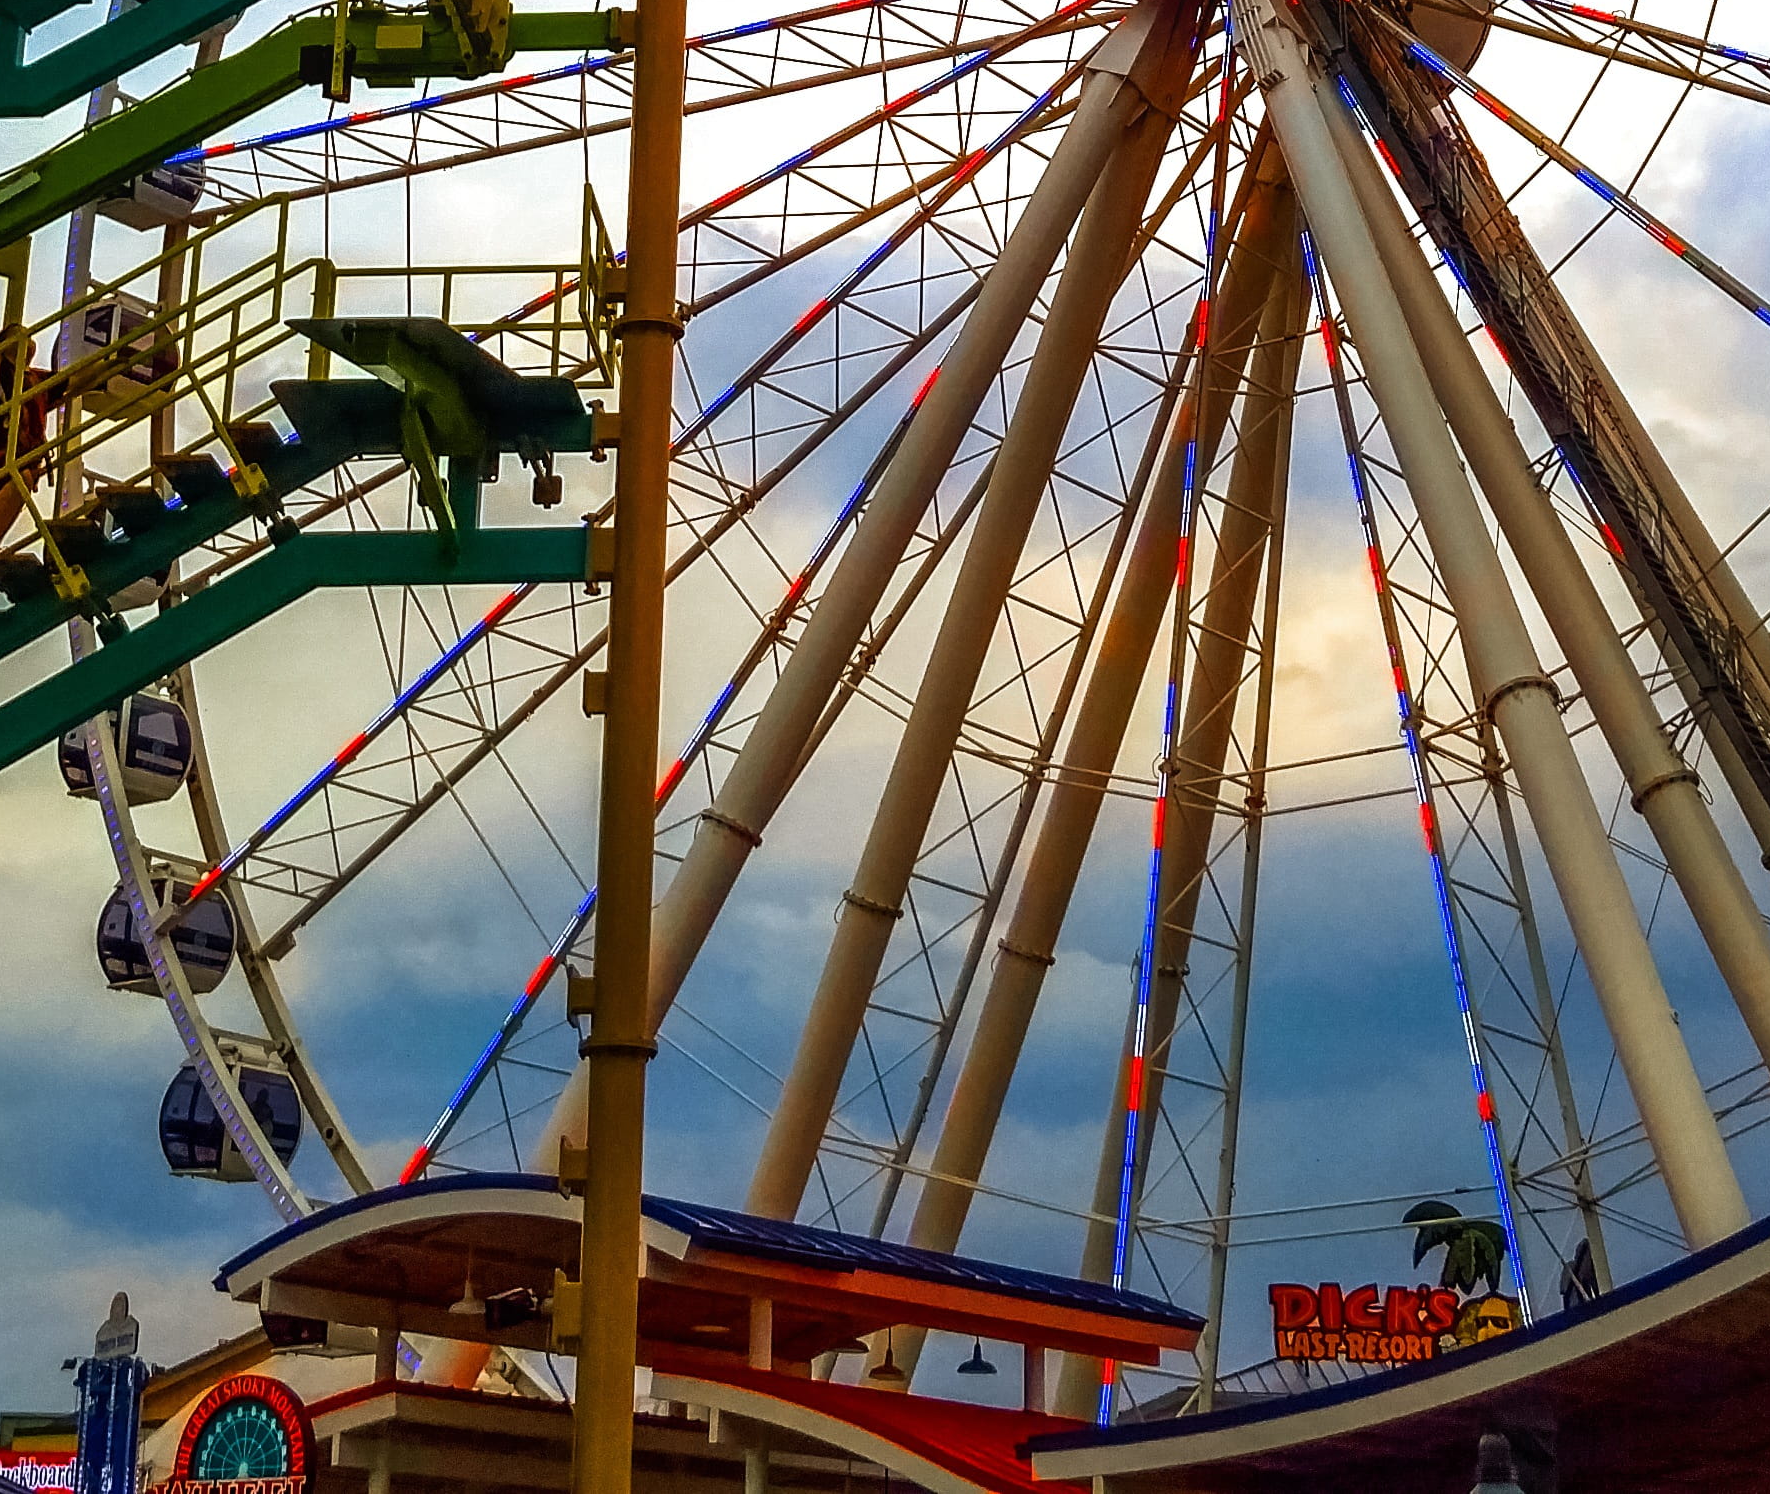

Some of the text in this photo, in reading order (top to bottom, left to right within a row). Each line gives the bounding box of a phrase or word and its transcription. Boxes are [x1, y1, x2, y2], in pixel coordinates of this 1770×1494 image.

[1269, 1282, 1459, 1333] DICK'S
[1277, 1332, 1433, 1361] LAST RESORT
[176, 1377, 305, 1476] THE GREAT SMOKY MOUNTAIN
